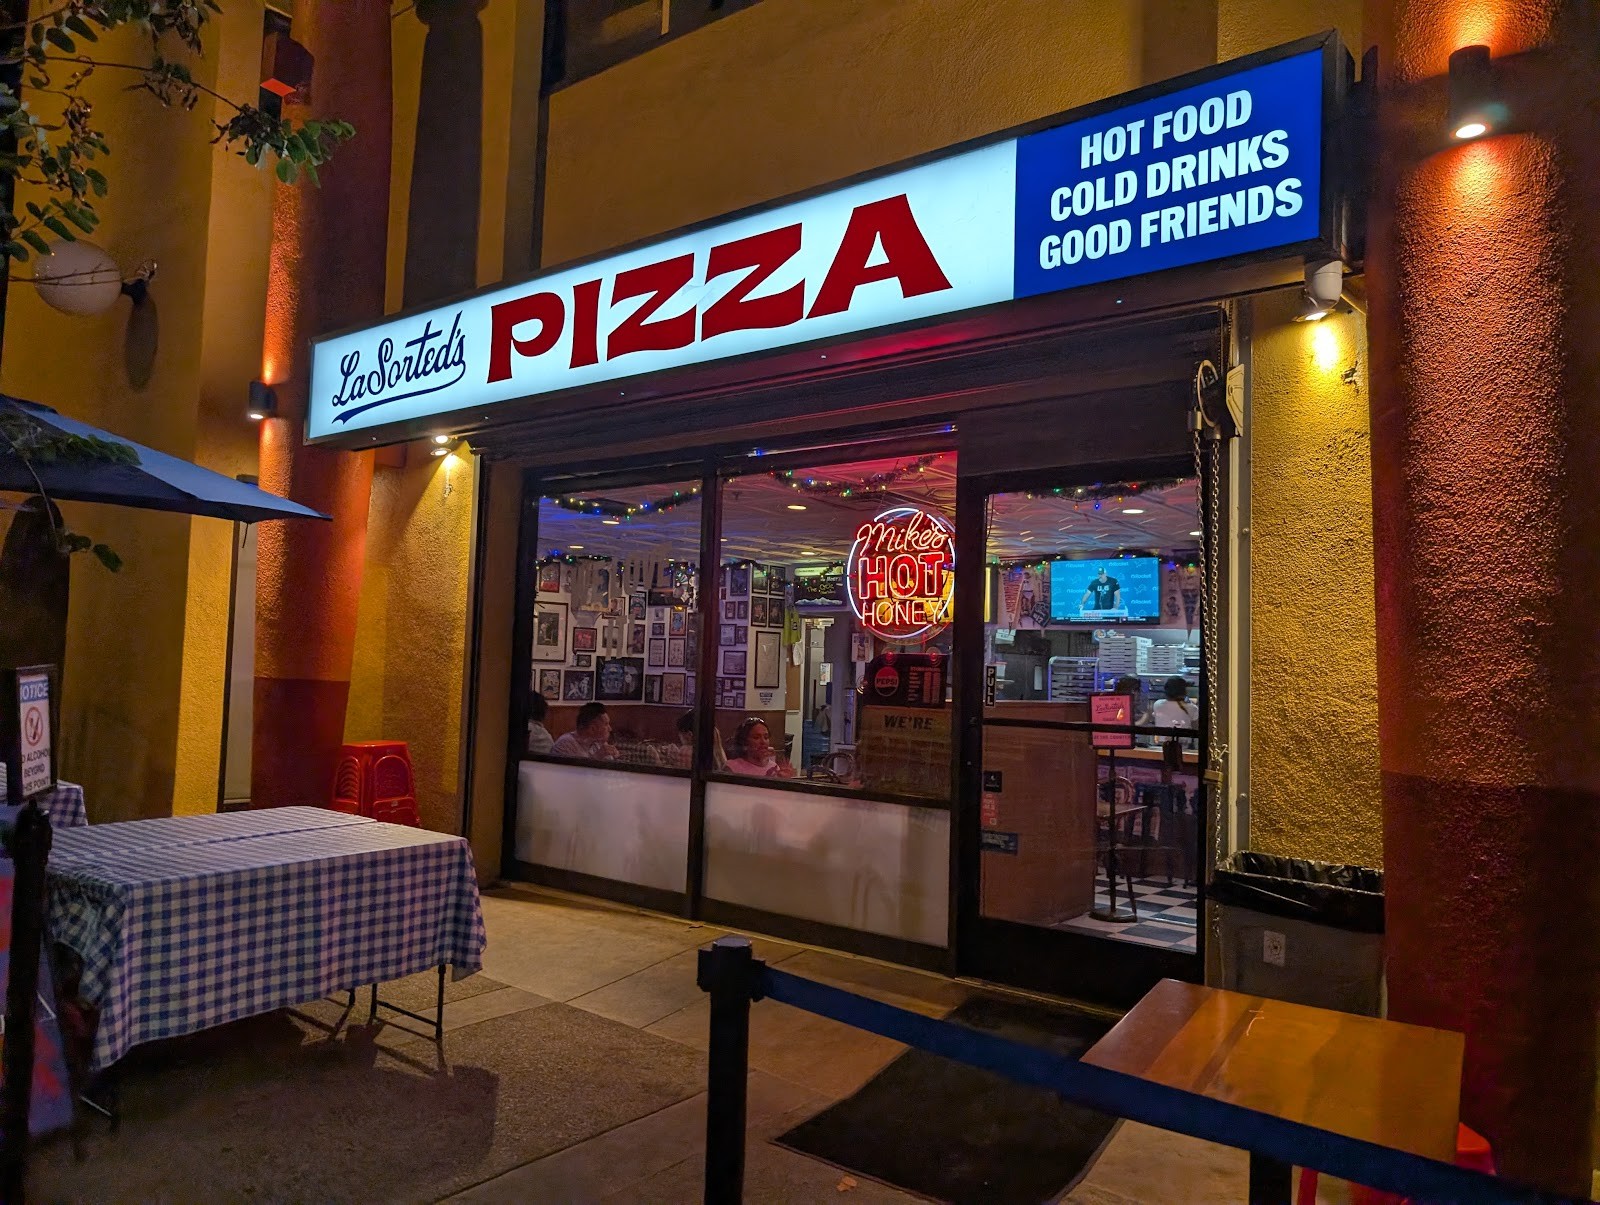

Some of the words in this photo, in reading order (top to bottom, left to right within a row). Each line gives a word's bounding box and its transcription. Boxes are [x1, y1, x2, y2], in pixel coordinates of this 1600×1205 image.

[1080, 119, 1145, 170] HOT
[1152, 89, 1253, 149] FOOD
[1050, 170, 1138, 222] COLD
[1146, 129, 1290, 199] DRINKS
[1039, 218, 1132, 270] GOOD
[1140, 177, 1303, 248] FRIENDS
[486, 193, 953, 384] PIZZA
[856, 510, 949, 556] Mike's
[858, 551, 945, 600] HOT
[862, 599, 942, 626] HONEY
[987, 667, 995, 706] PULL
[884, 714, 934, 730] WE'RE
